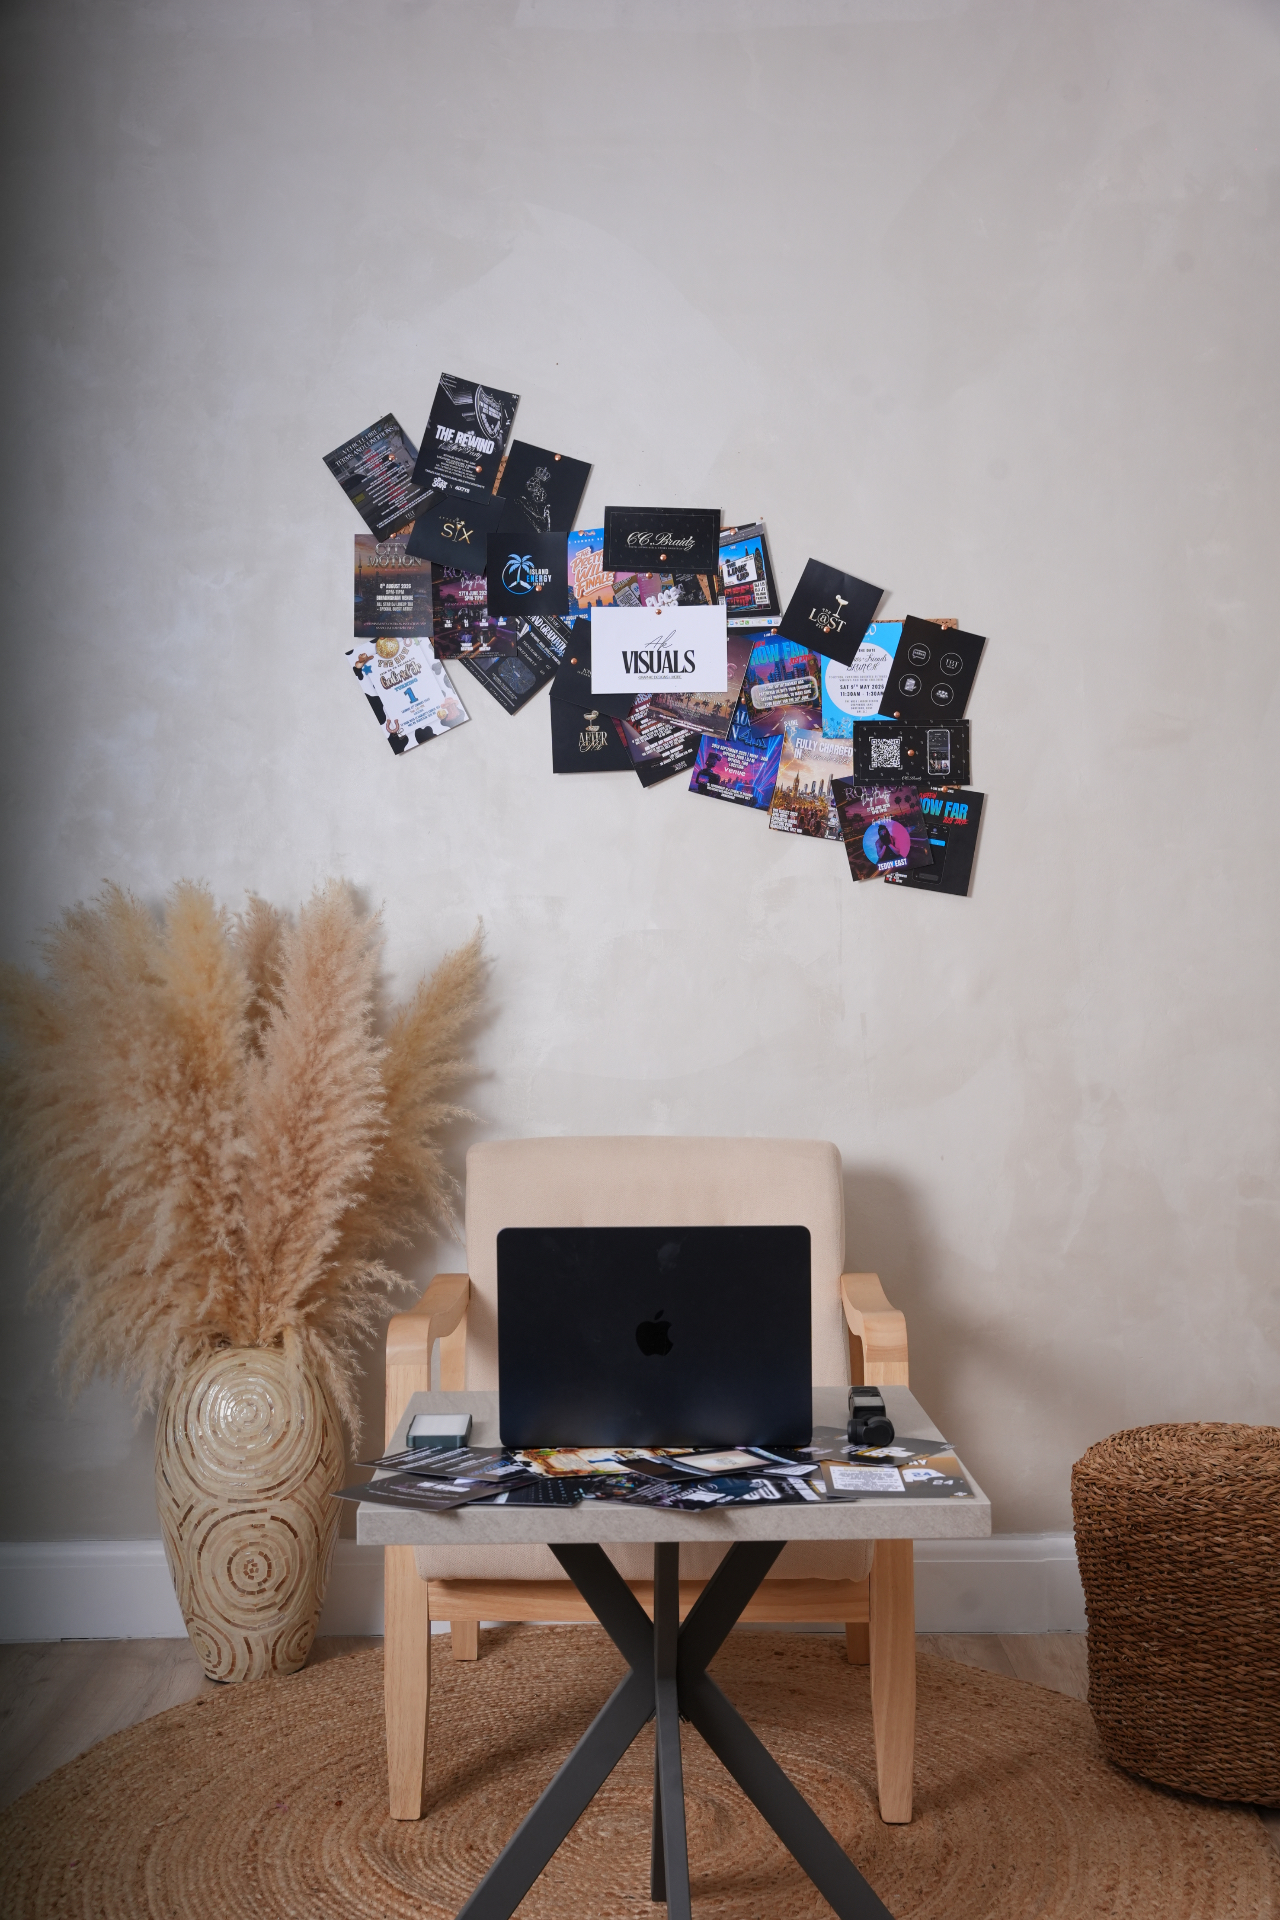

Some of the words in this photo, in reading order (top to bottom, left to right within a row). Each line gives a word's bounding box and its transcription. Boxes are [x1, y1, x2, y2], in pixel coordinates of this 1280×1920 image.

[335, 454, 354, 466] TERMS
[363, 426, 394, 450] CONDITIONS
[436, 424, 455, 442] THE
[455, 431, 494, 454] REWIND
[576, 547, 591, 558] THE
[366, 554, 422, 568] MOTION
[570, 549, 604, 574] PRETT
[575, 563, 604, 584] WIL
[727, 563, 748, 577] LINK
[736, 572, 750, 581] UP
[574, 572, 615, 599] FINALE
[622, 650, 696, 674] VISUALS
[394, 677, 418, 692] TURNING
[404, 687, 418, 704] 1
[579, 732, 608, 746] AFTER
[794, 748, 802, 759] IN
[796, 738, 818, 751] FULLY
[819, 742, 853, 757] CHARGED
[724, 767, 746, 777] venue
[920, 798, 943, 817] OW
[944, 801, 968, 820] FAR
[878, 861, 894, 870] ZEDDY
[895, 858, 907, 867] EAST
